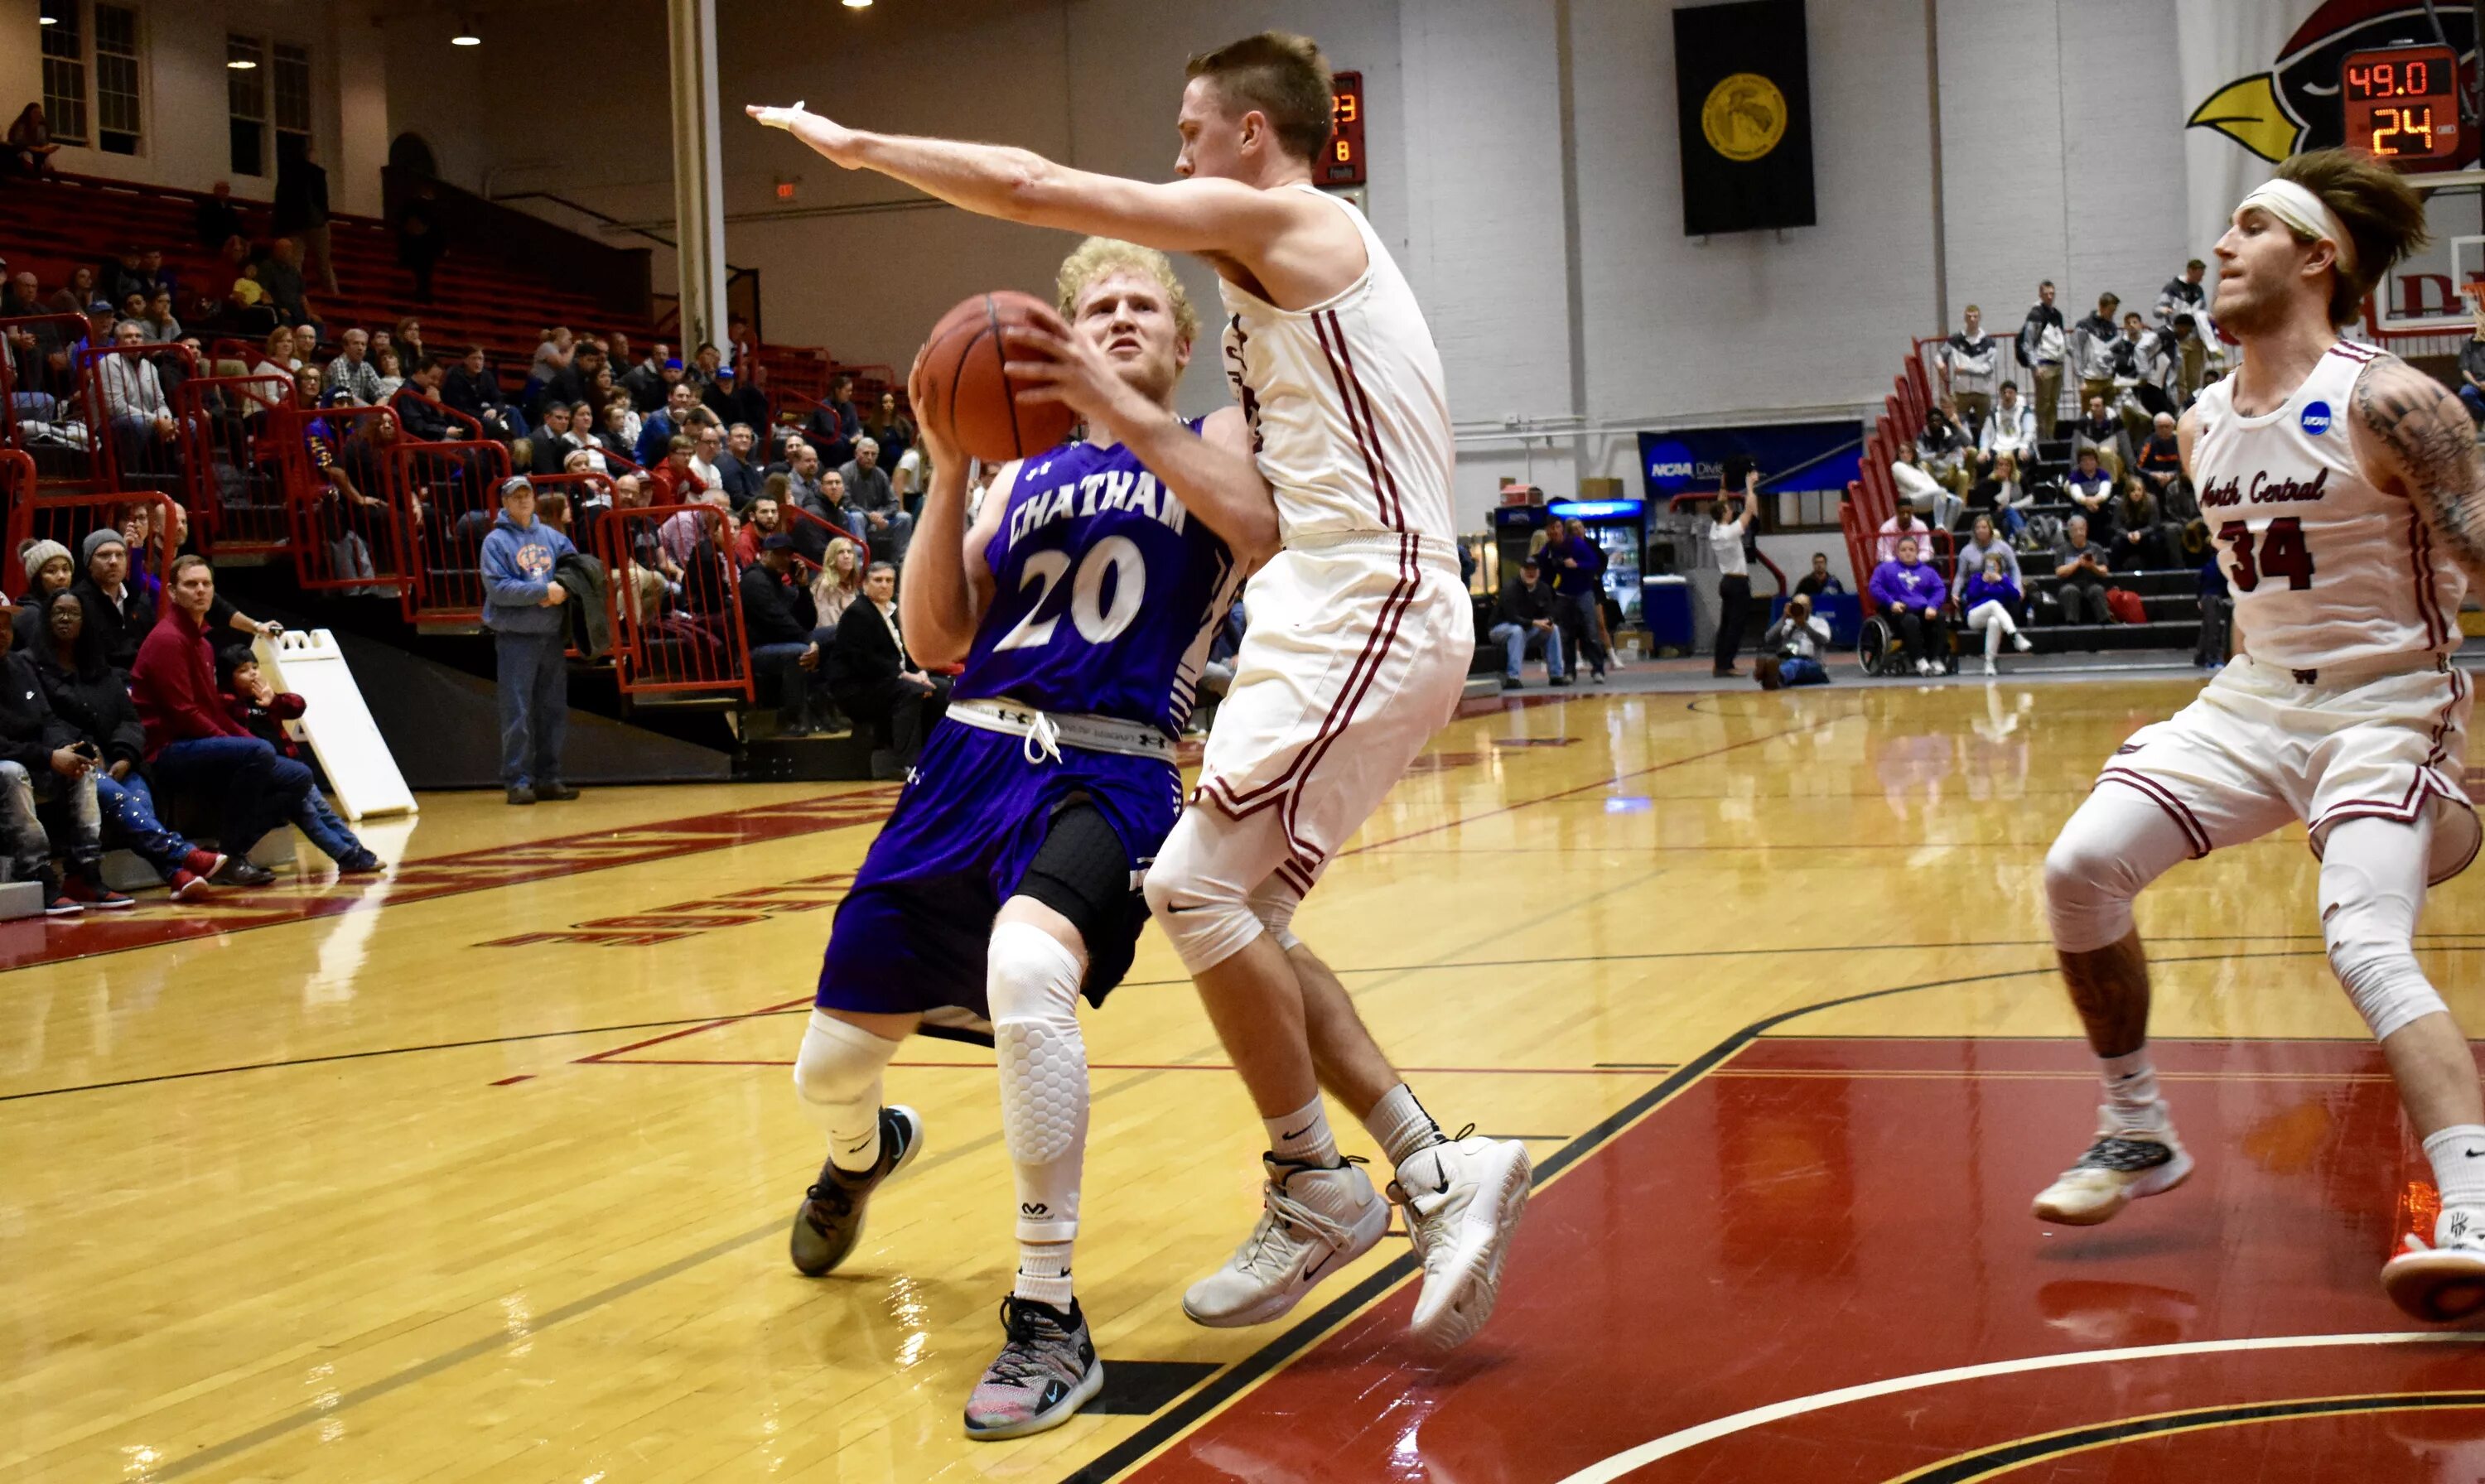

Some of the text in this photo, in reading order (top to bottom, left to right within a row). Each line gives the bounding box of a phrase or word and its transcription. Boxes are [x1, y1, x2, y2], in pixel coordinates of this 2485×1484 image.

[2349, 62, 2427, 97] 49.0
[1336, 140, 1350, 161] 8
[2372, 108, 2432, 155] 24
[1651, 462, 1694, 478] NCAA
[2200, 467, 2328, 508] North Central
[1008, 470, 1187, 553] CHATHAM
[2217, 516, 2315, 592] 34
[992, 535, 1146, 653] 20
